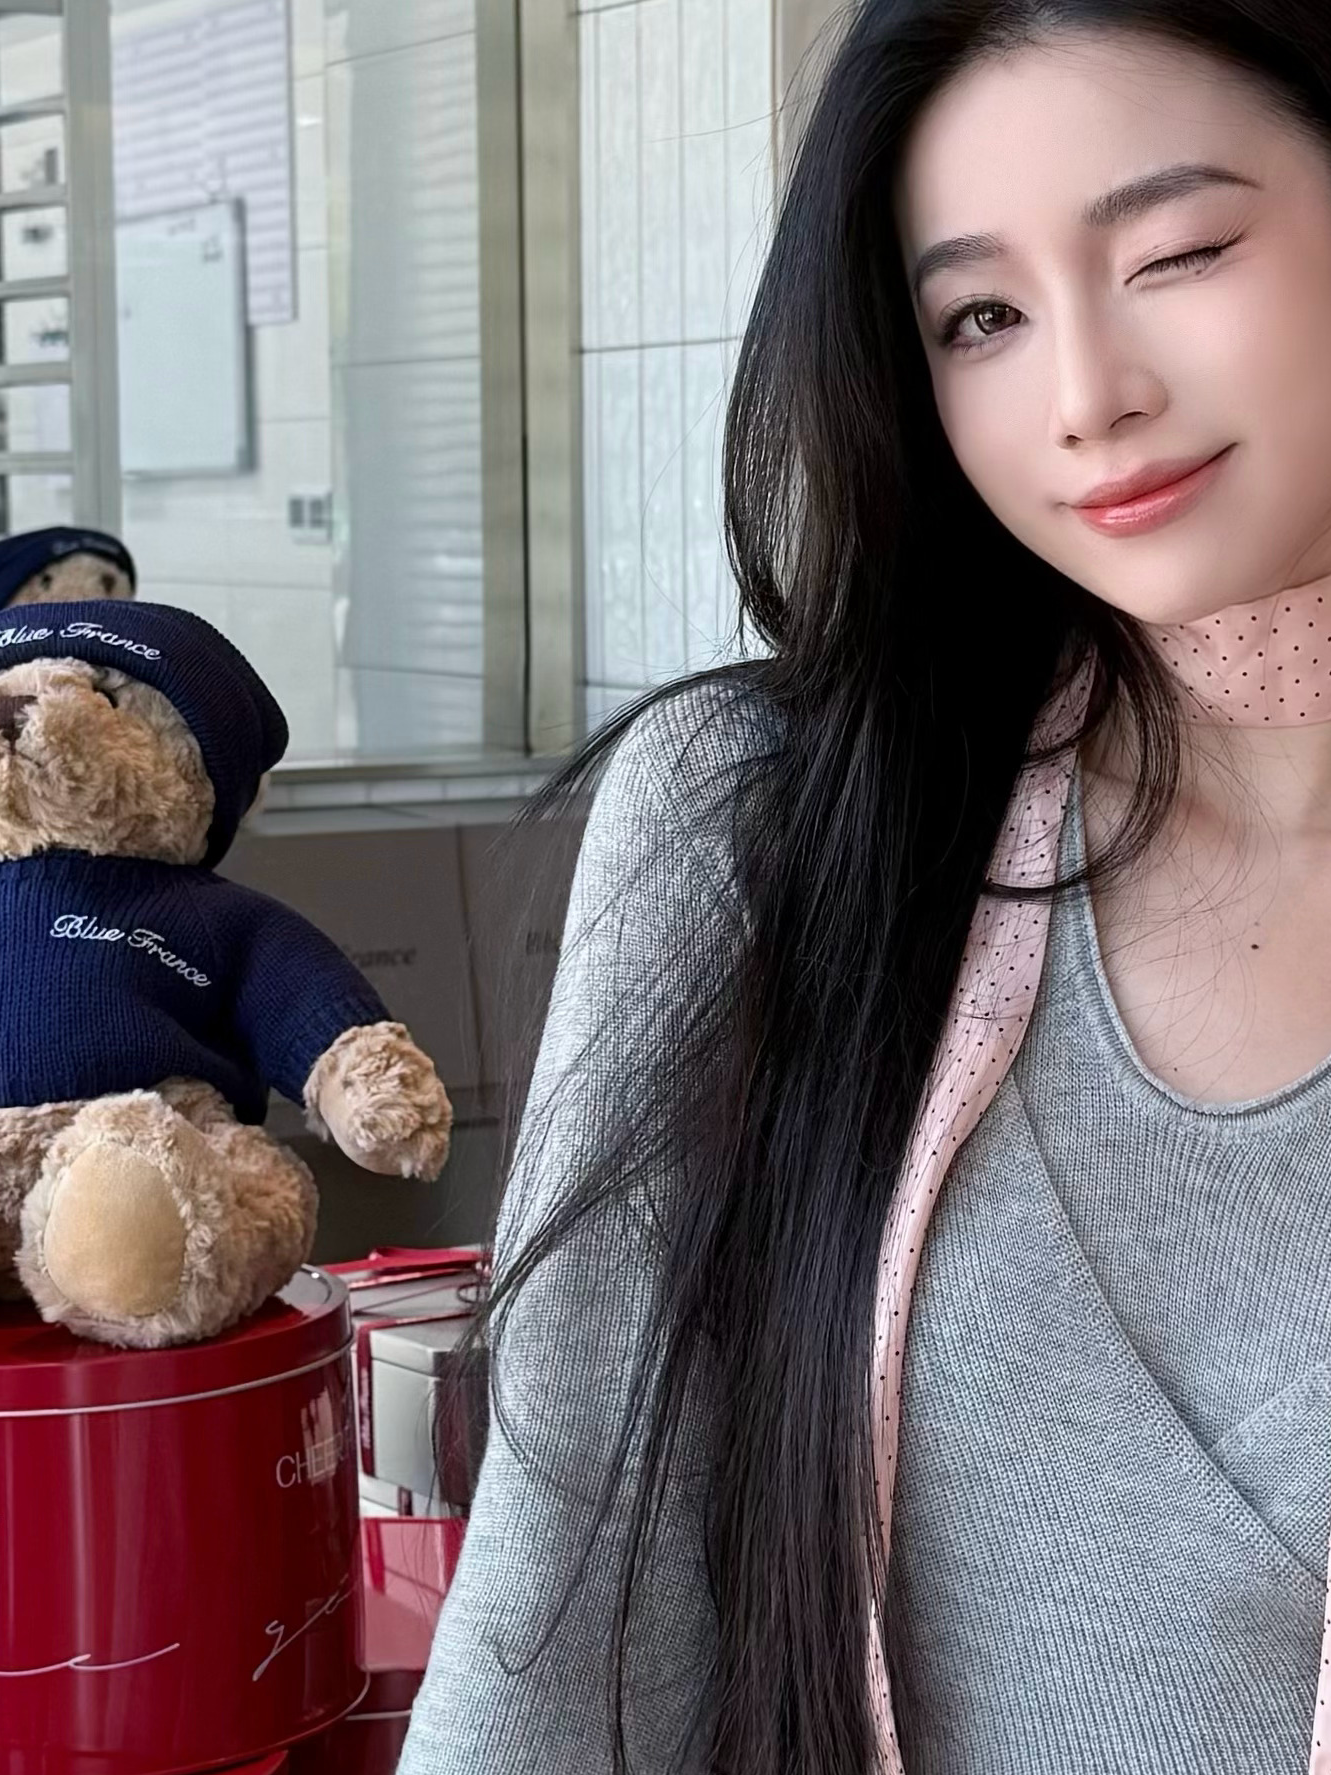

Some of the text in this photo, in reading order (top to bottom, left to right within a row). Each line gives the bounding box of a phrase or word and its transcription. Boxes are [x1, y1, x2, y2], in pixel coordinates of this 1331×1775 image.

[59, 622, 162, 660] France
[50, 914, 212, 987] Blue France
